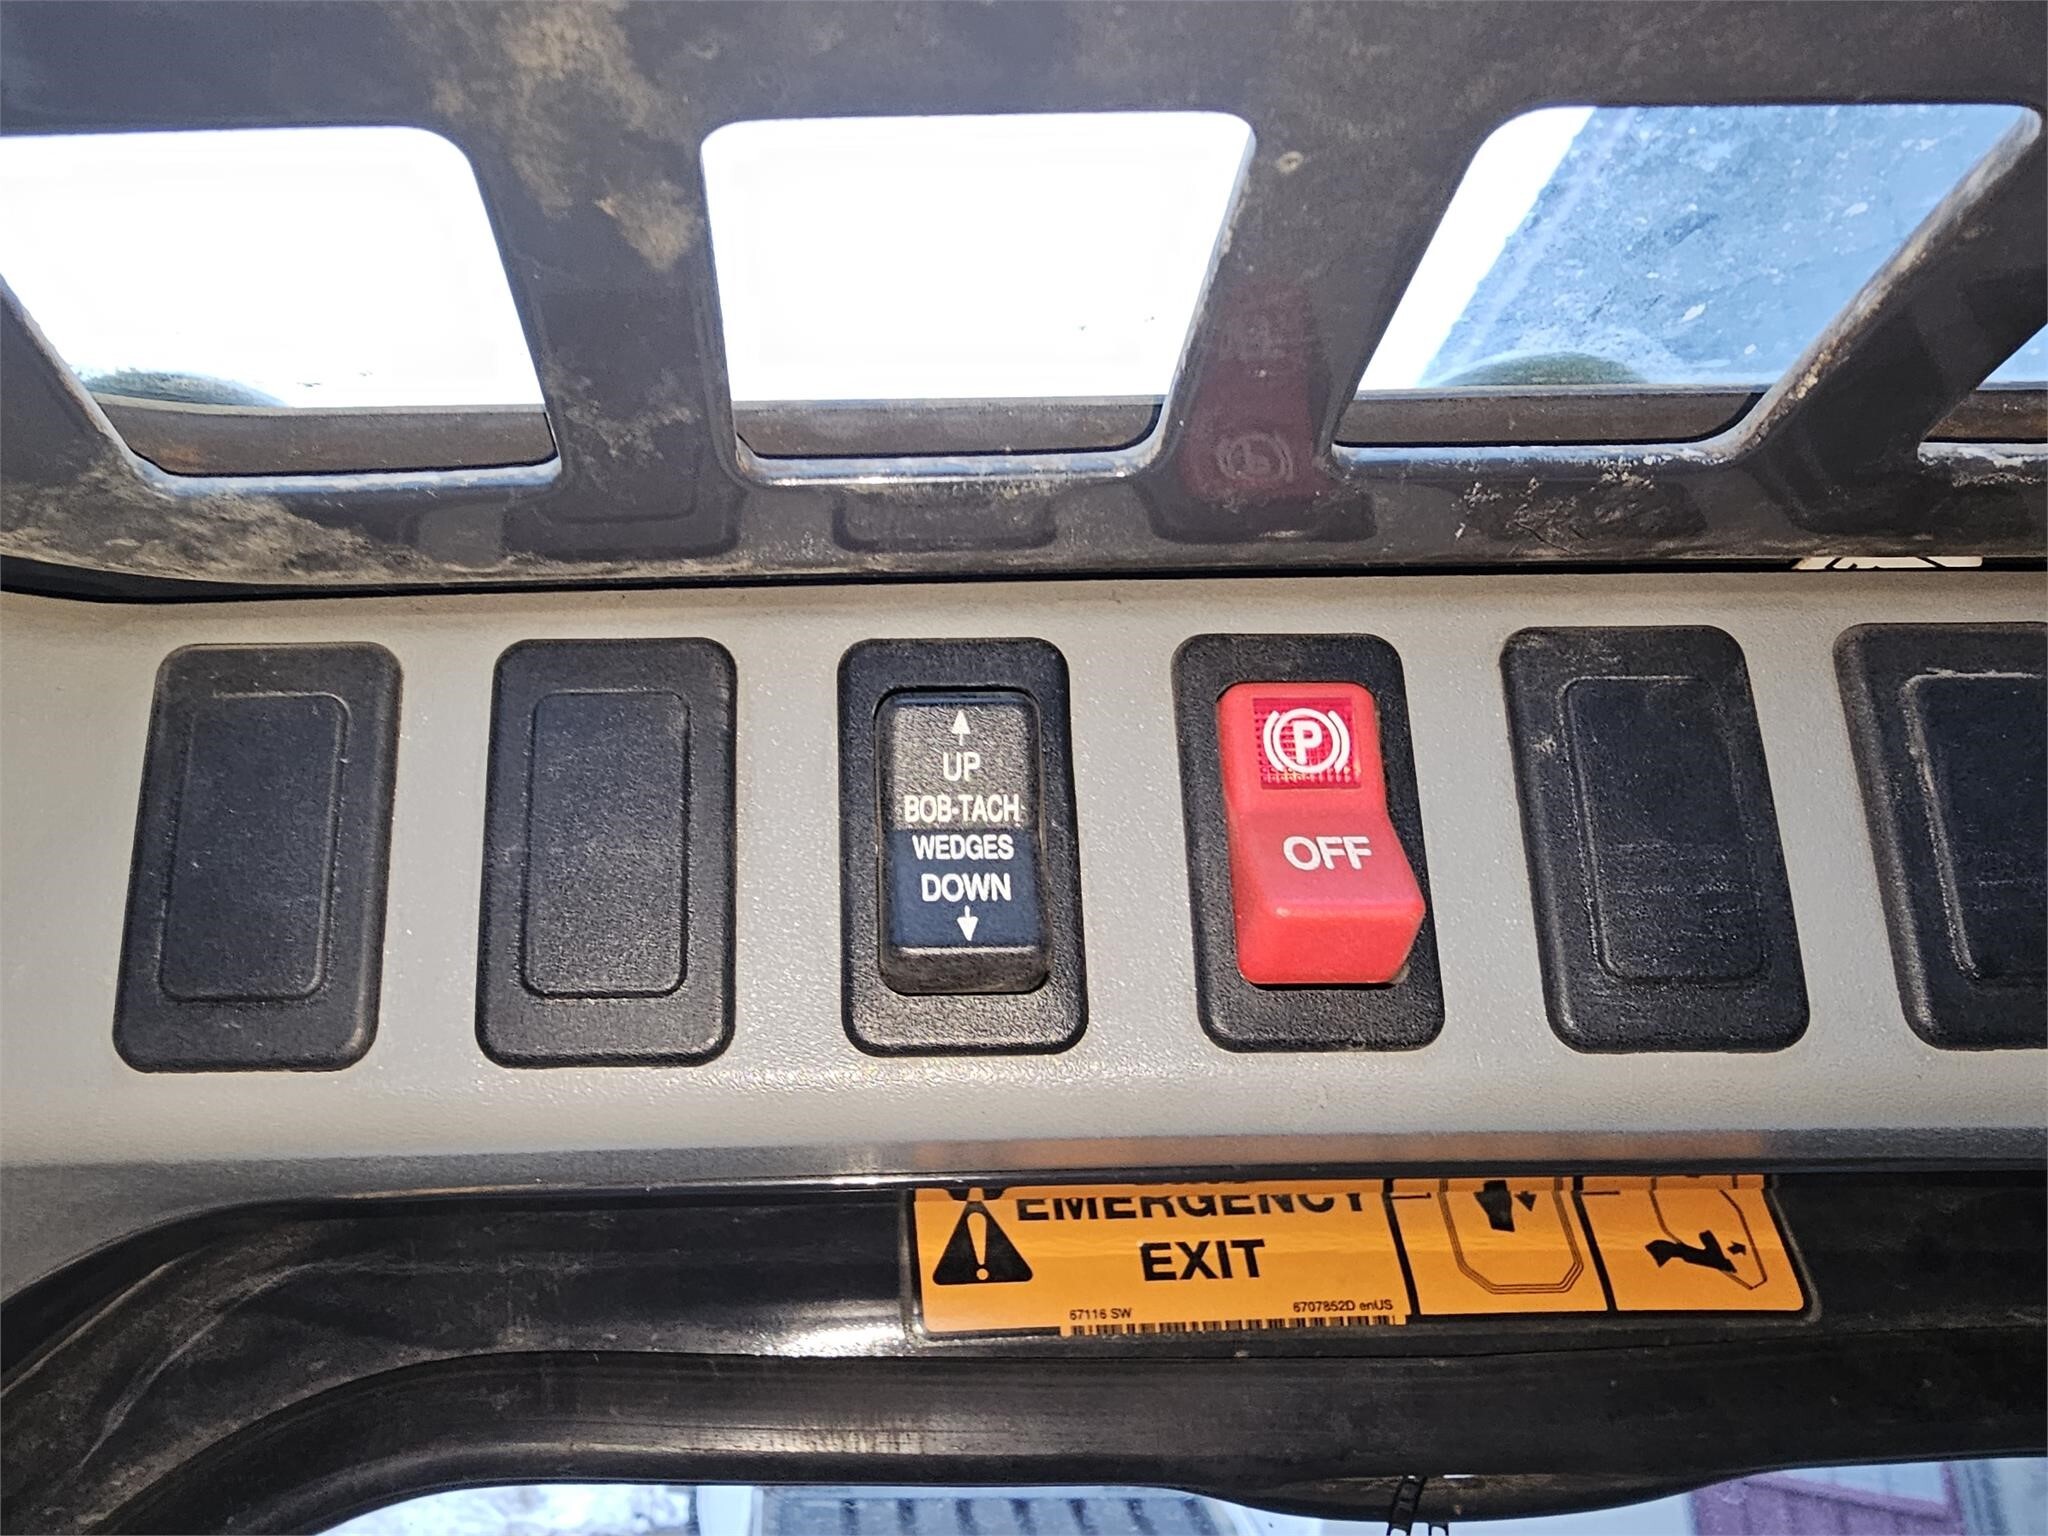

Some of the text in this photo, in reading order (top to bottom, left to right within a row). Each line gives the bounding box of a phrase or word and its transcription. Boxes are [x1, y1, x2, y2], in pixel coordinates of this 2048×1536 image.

[943, 751, 981, 782] UP
[904, 794, 1020, 823] BOB-TACH
[912, 834, 1015, 860] WEDGES
[1282, 836, 1373, 871] OFF
[921, 873, 1012, 902] DOWN
[1139, 1239, 1266, 1282] EXIT
[1110, 1307, 1132, 1319] SW
[1293, 1299, 1393, 1313] 6707852D enUS
